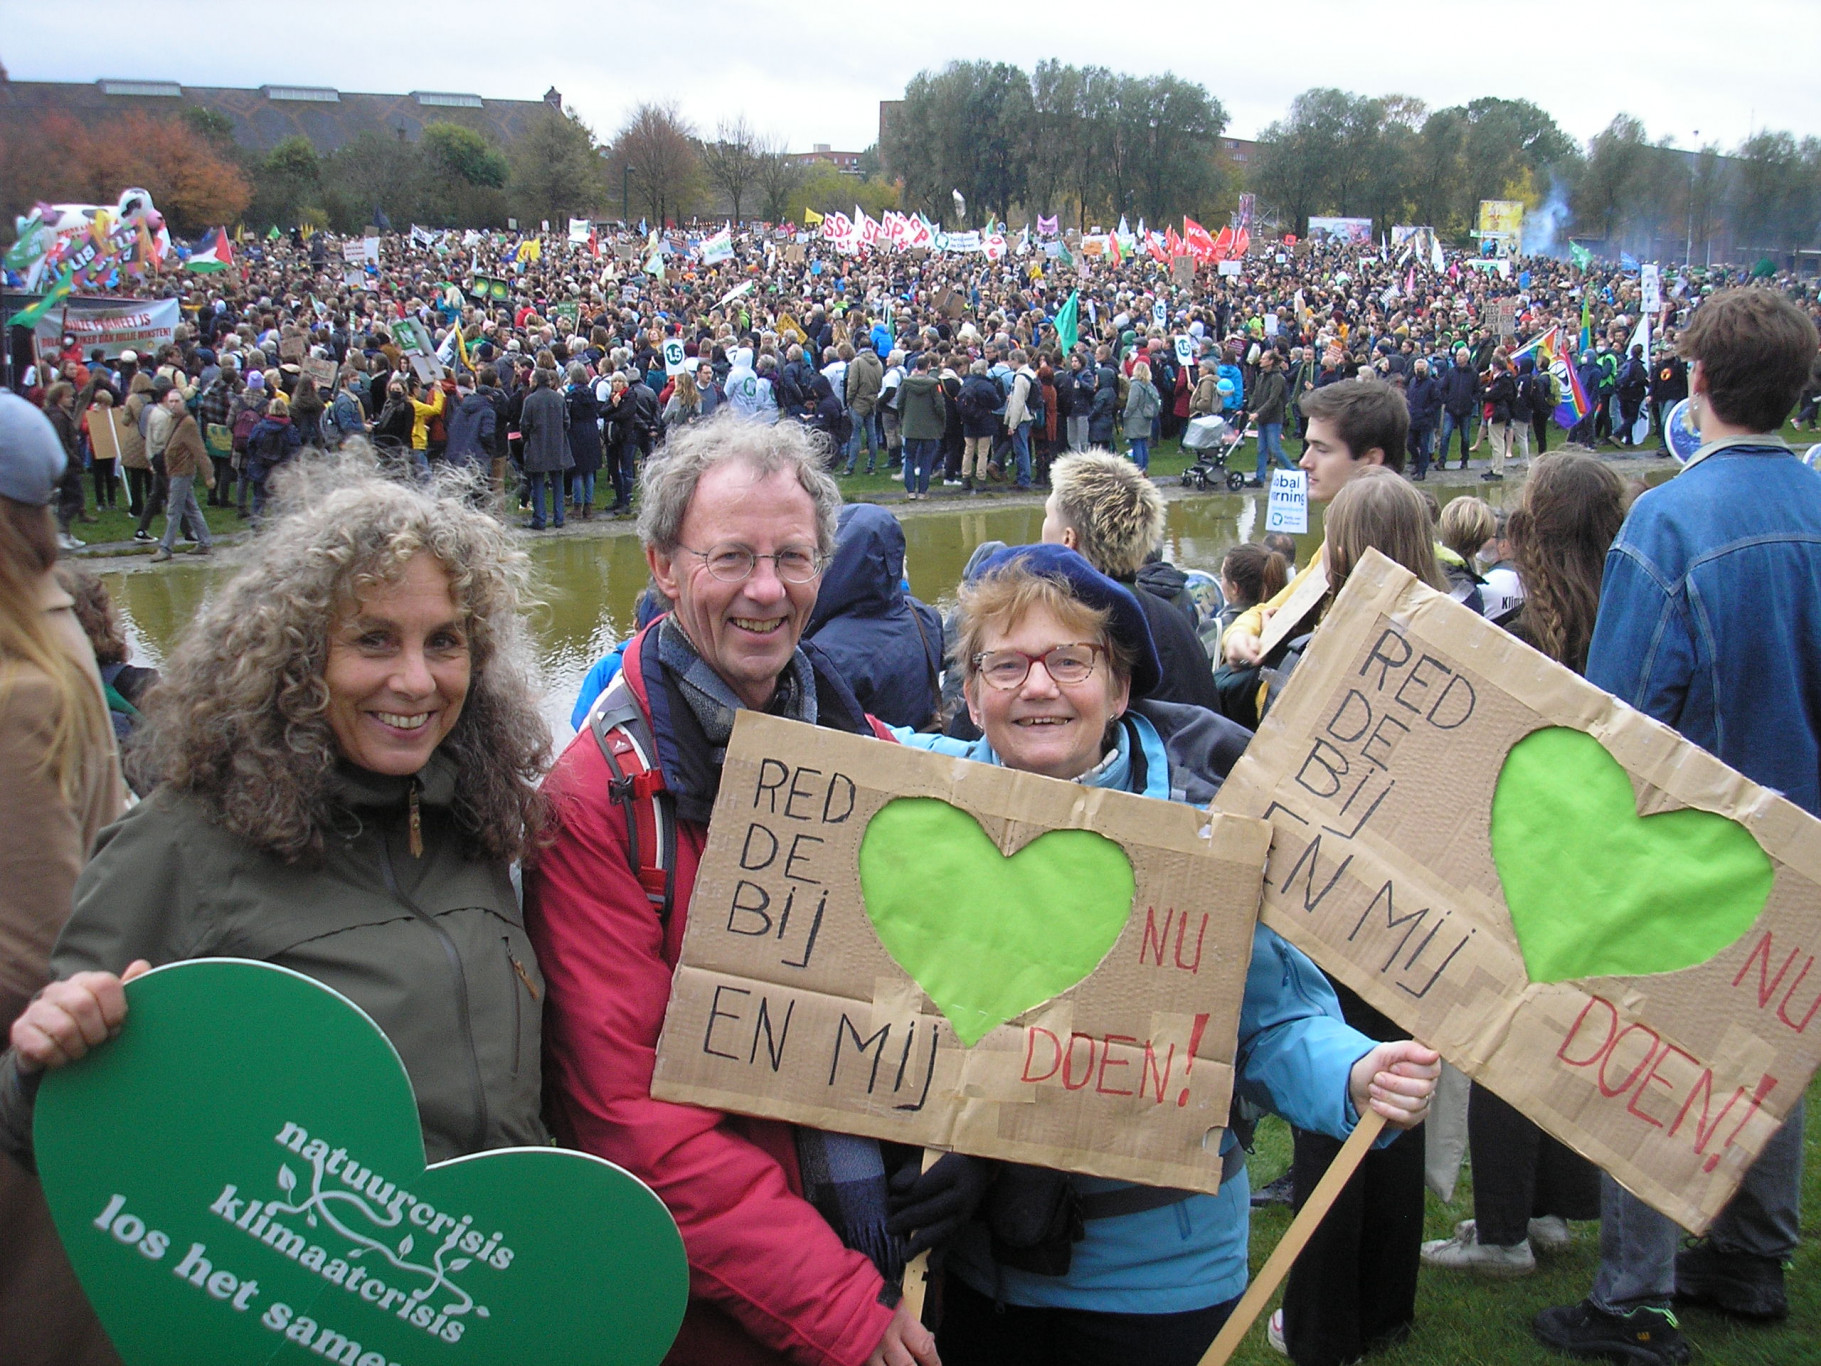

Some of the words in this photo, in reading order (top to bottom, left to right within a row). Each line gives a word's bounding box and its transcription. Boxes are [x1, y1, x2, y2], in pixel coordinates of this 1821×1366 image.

[1359, 628, 1476, 730] RED
[1327, 689, 1411, 771] DE
[753, 757, 857, 824] RED
[739, 822, 825, 885] DE
[1139, 905, 1209, 975] NU
[1731, 930, 1821, 1033] NU
[703, 985, 795, 1072] EN
[1020, 1012, 1211, 1108] DOEN!
[1556, 995, 1778, 1174] DOEN!
[274, 1120, 515, 1270] natuurcrisis
[93, 1193, 171, 1260] los
[173, 1242, 260, 1312] het
[262, 1302, 402, 1366] same
[209, 1184, 466, 1344] klimaatcrisis
